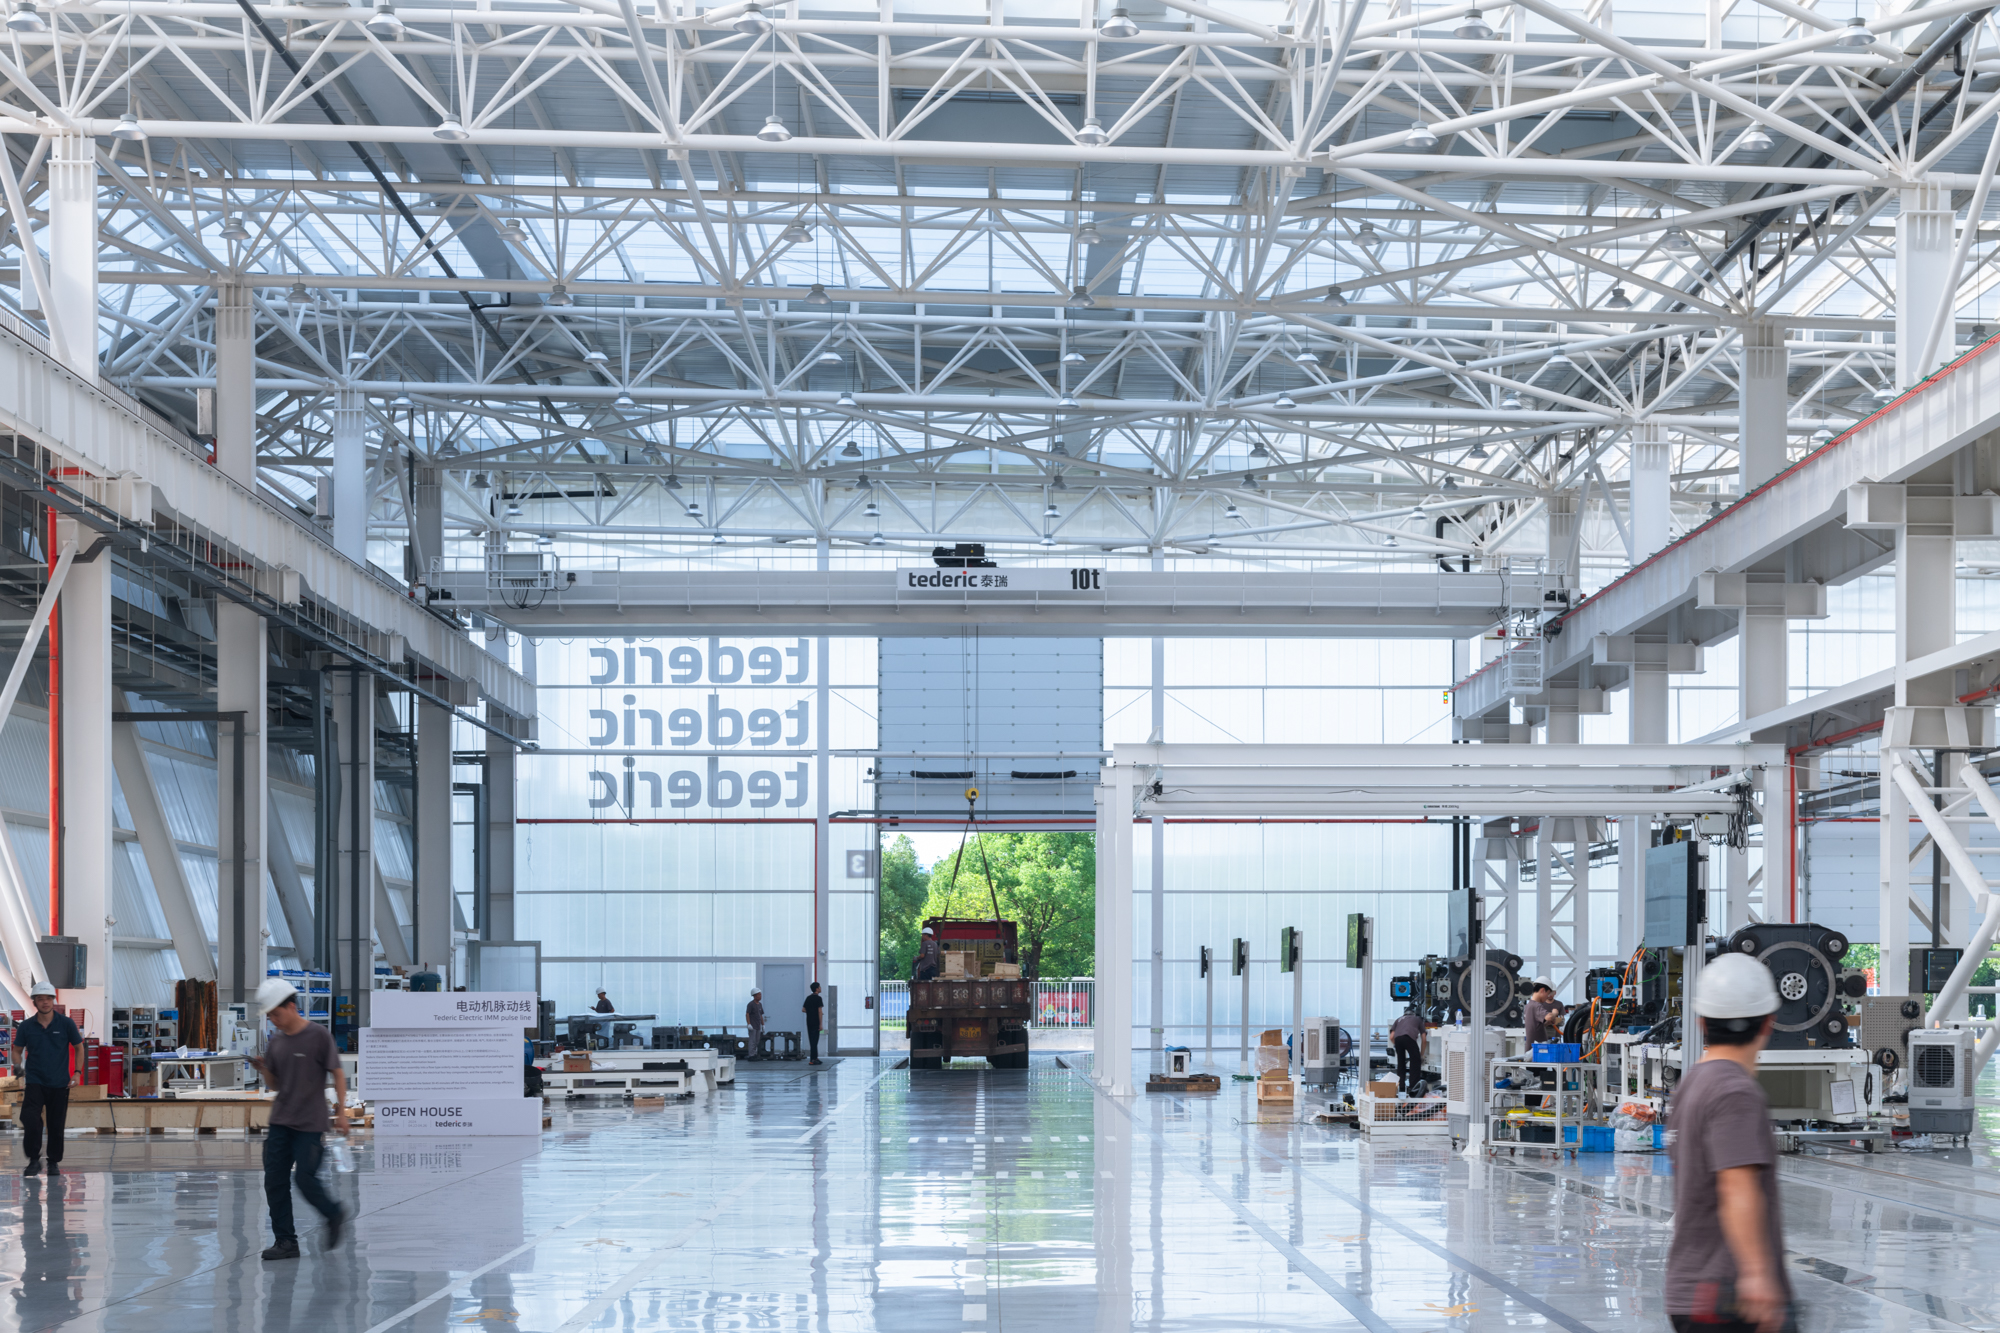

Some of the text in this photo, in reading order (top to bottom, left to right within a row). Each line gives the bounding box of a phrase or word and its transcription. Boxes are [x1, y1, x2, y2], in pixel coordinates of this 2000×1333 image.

[908, 570, 1008, 588] tederic 泰瑞
[1070, 568, 1100, 590] 10t
[456, 1000, 532, 1012] 电动机脉动线
[382, 1107, 462, 1116] OPEN HOUSE
